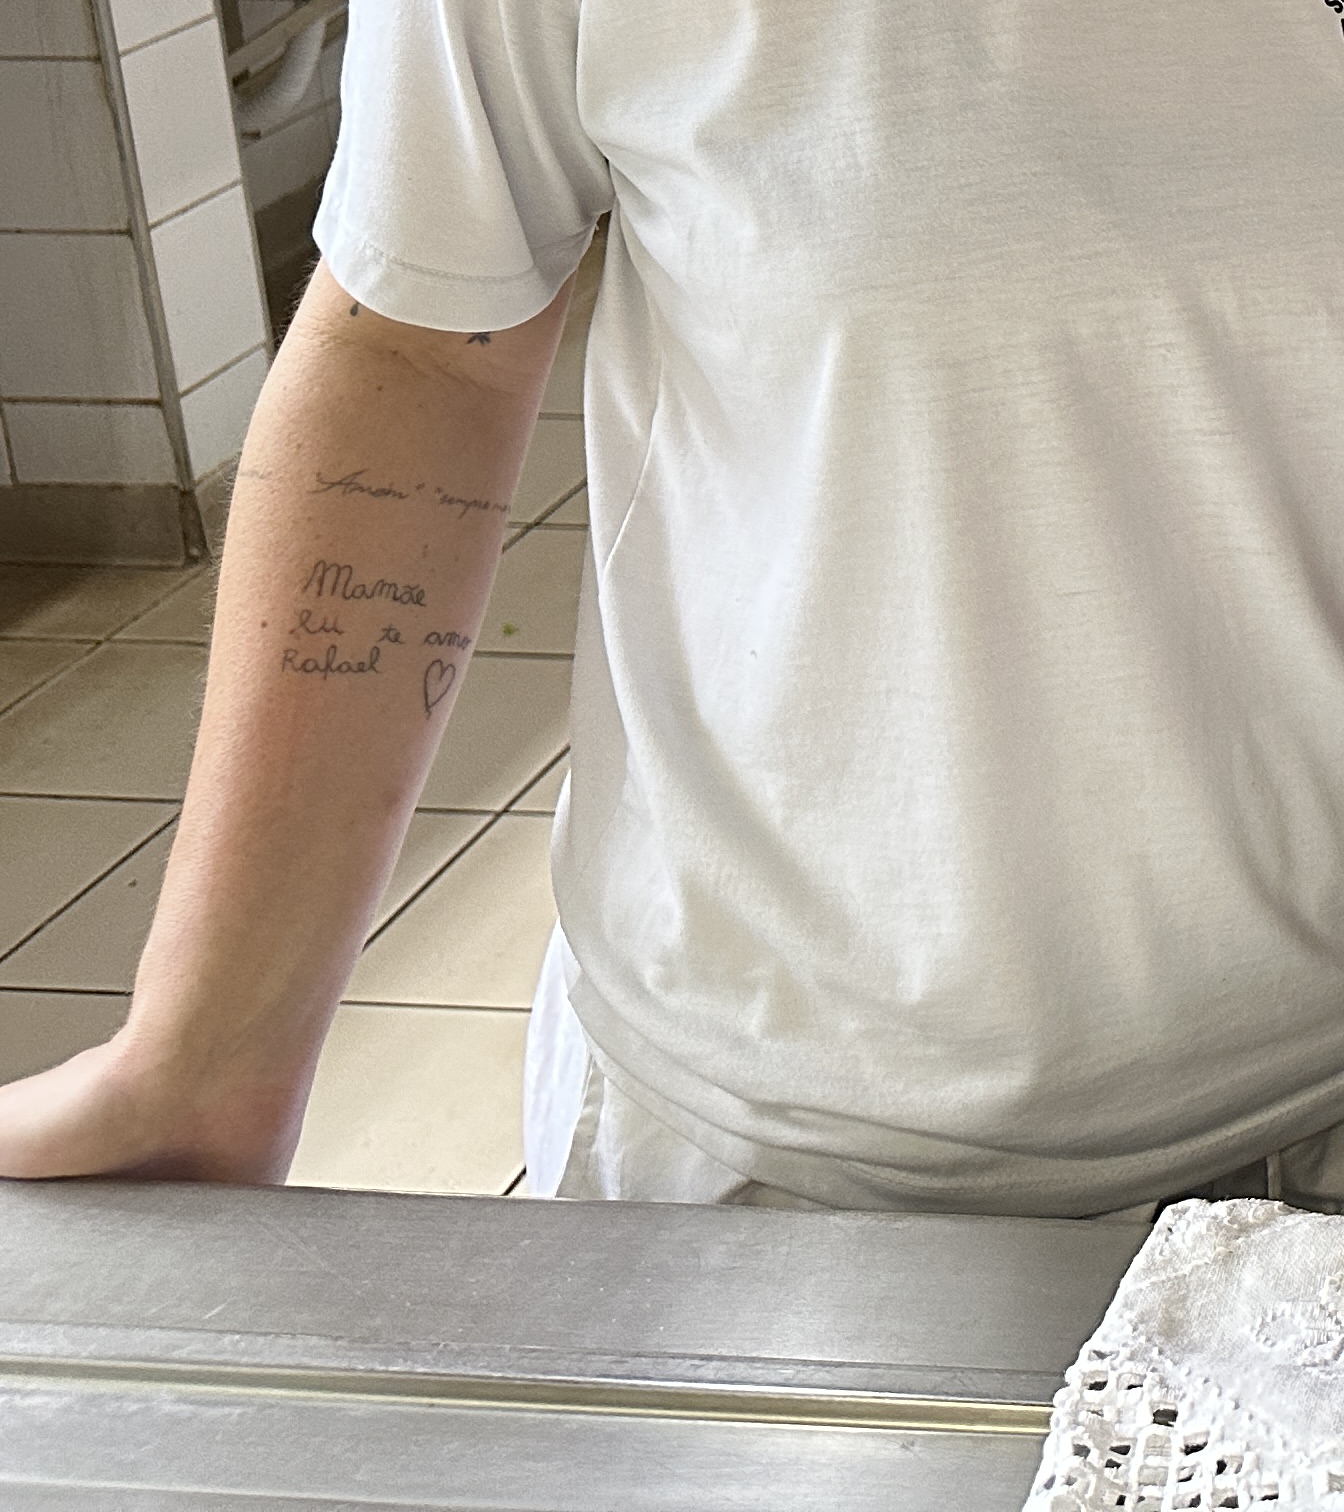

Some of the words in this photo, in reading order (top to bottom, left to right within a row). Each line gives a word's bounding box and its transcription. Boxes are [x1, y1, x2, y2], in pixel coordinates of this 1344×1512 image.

[303, 560, 427, 607] Mamãe
[378, 624, 404, 645] te
[281, 644, 383, 681] Rafael
